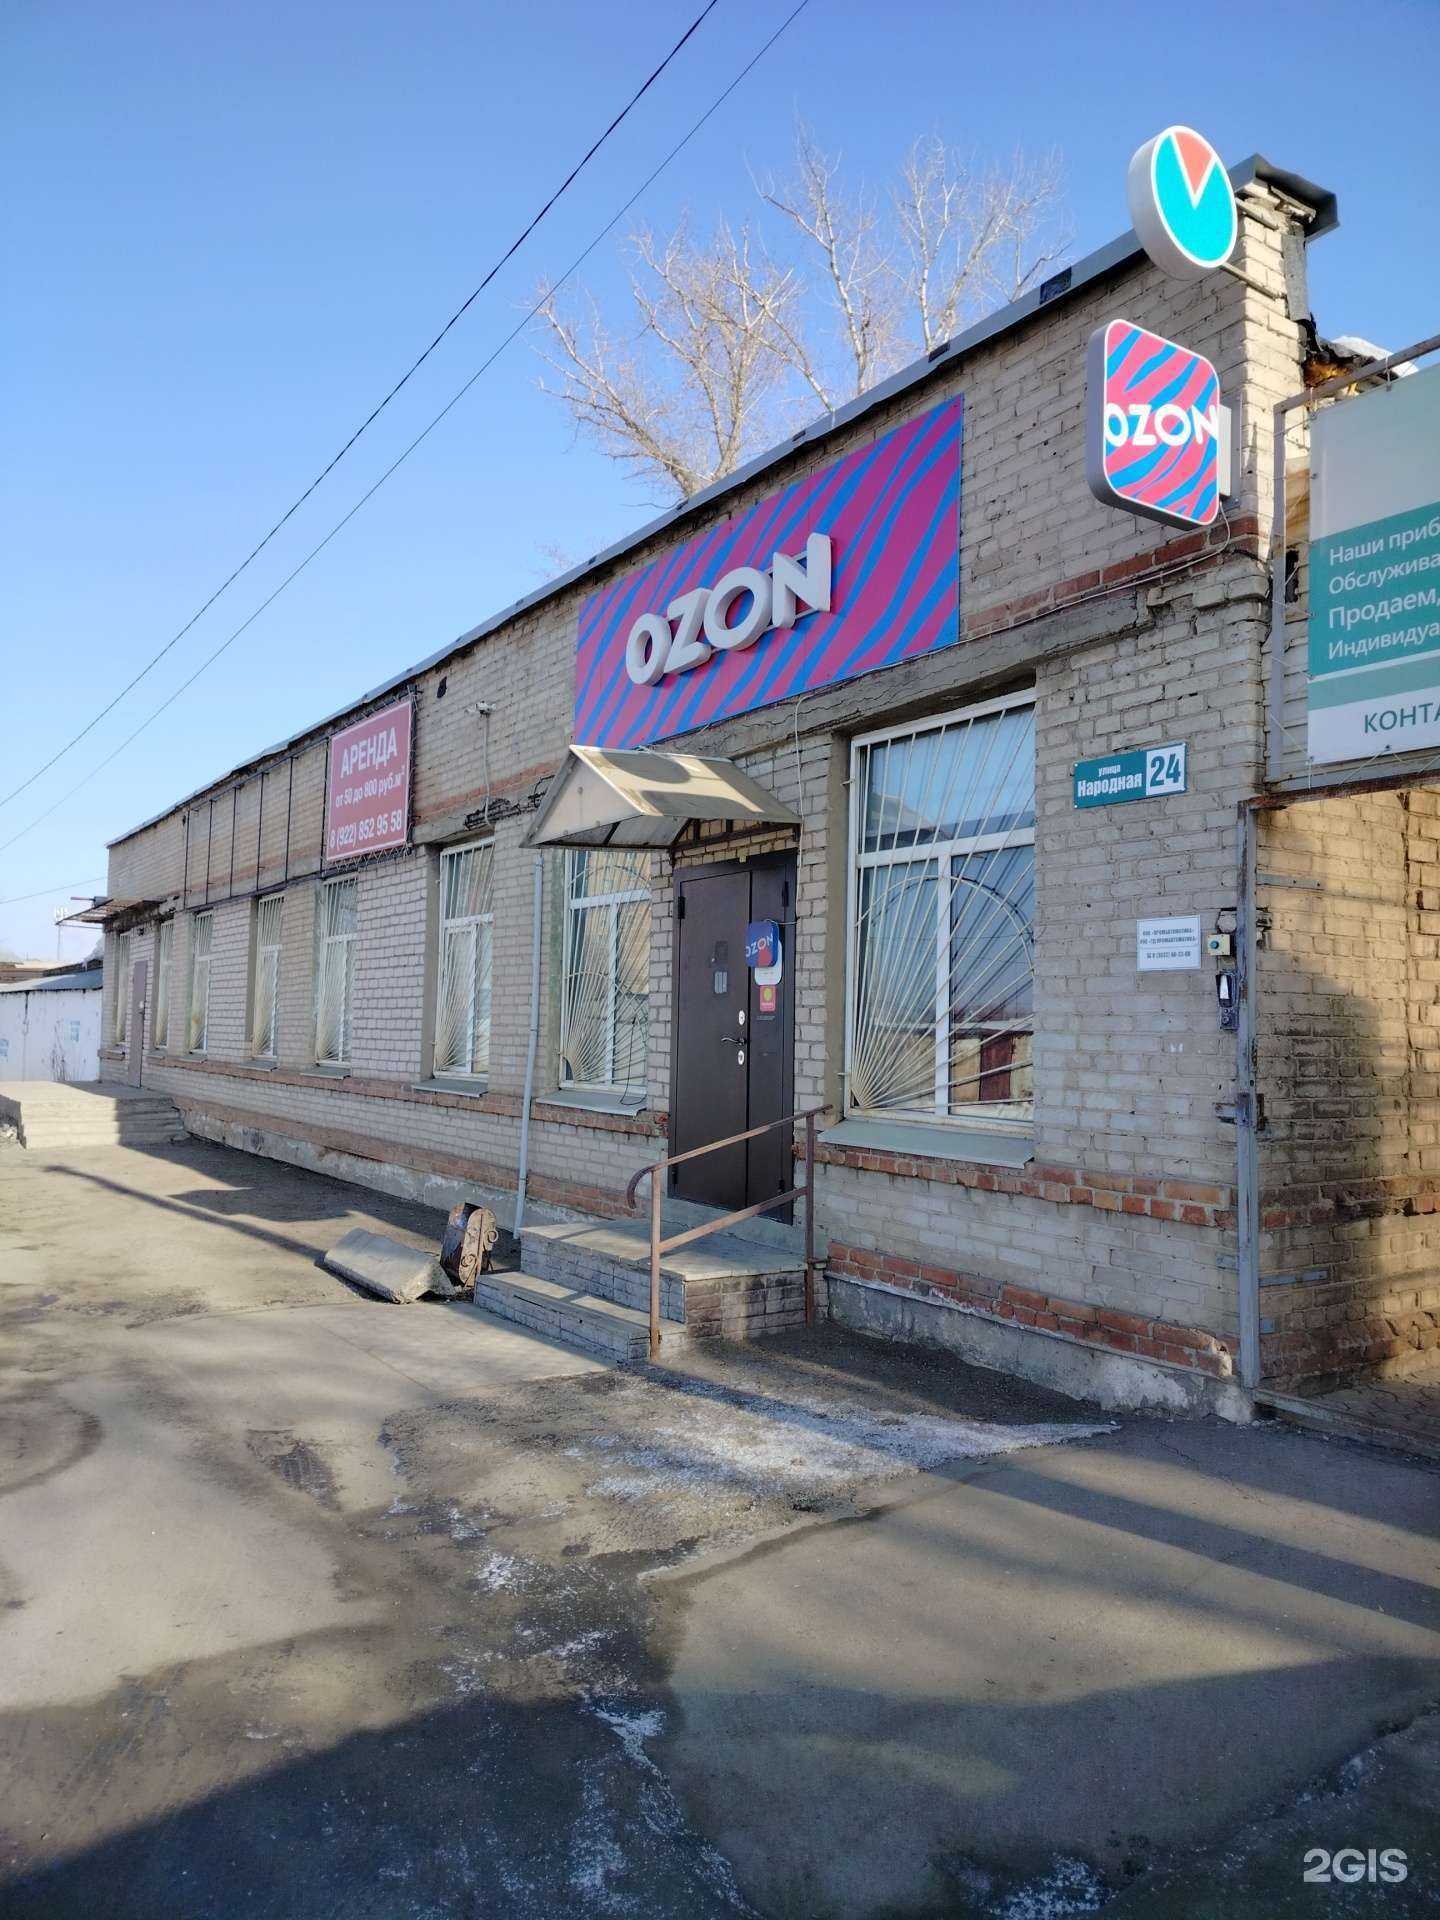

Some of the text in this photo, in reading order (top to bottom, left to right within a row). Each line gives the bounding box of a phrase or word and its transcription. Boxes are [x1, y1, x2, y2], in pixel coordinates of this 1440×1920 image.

[1105, 403, 1219, 446] OZON
[1329, 516, 1440, 566] Наши приб
[1328, 553, 1440, 595] Обслужива
[626, 532, 832, 686] OZON
[1328, 622, 1440, 660] Индивидуа
[340, 727, 398, 779] АРЕНДА
[1098, 764, 1121, 777] улица
[1150, 753, 1181, 787] 24
[1077, 773, 1142, 797] Народная
[329, 808, 402, 851] 8 (922) 852 95 58
[745, 927, 774, 957] OZON
